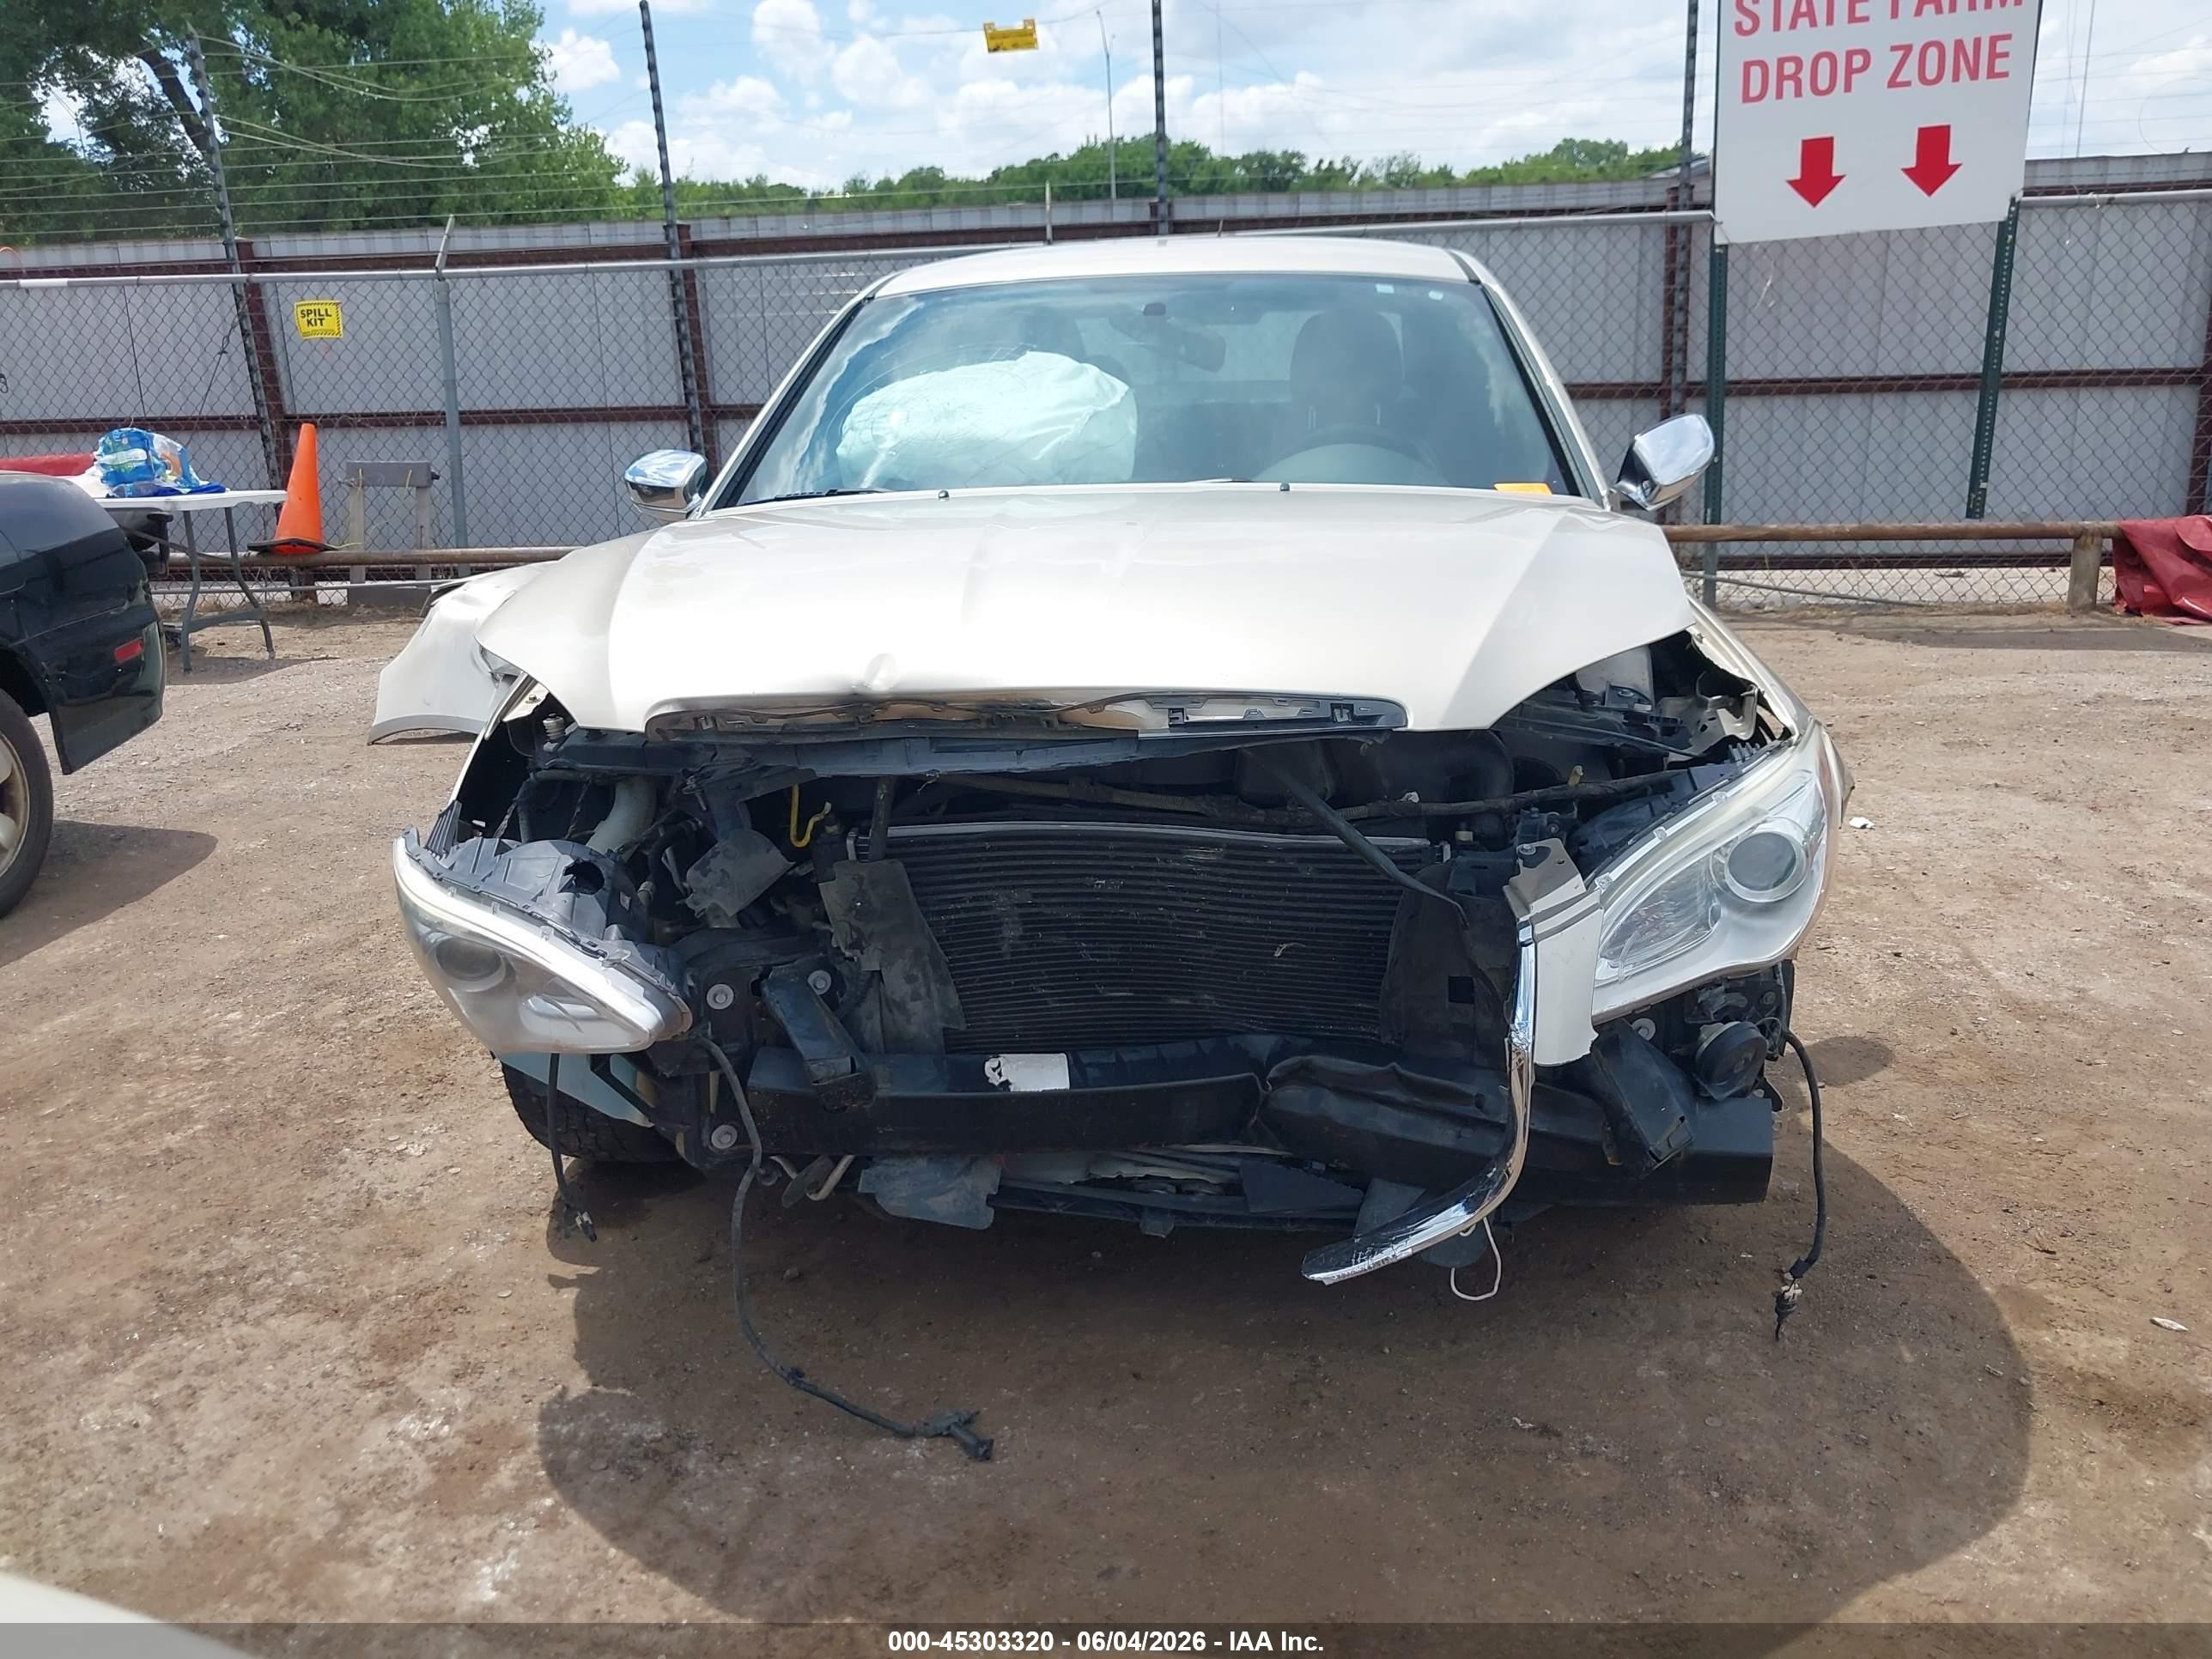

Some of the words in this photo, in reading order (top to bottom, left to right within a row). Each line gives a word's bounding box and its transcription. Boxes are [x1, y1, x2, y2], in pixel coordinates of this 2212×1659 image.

[1735, 0, 1870, 37] STATE
[1741, 47, 1873, 104] DROP
[1887, 33, 2014, 89] ZONE
[301, 308, 332, 319] SPILL
[307, 318, 325, 327] KIT
